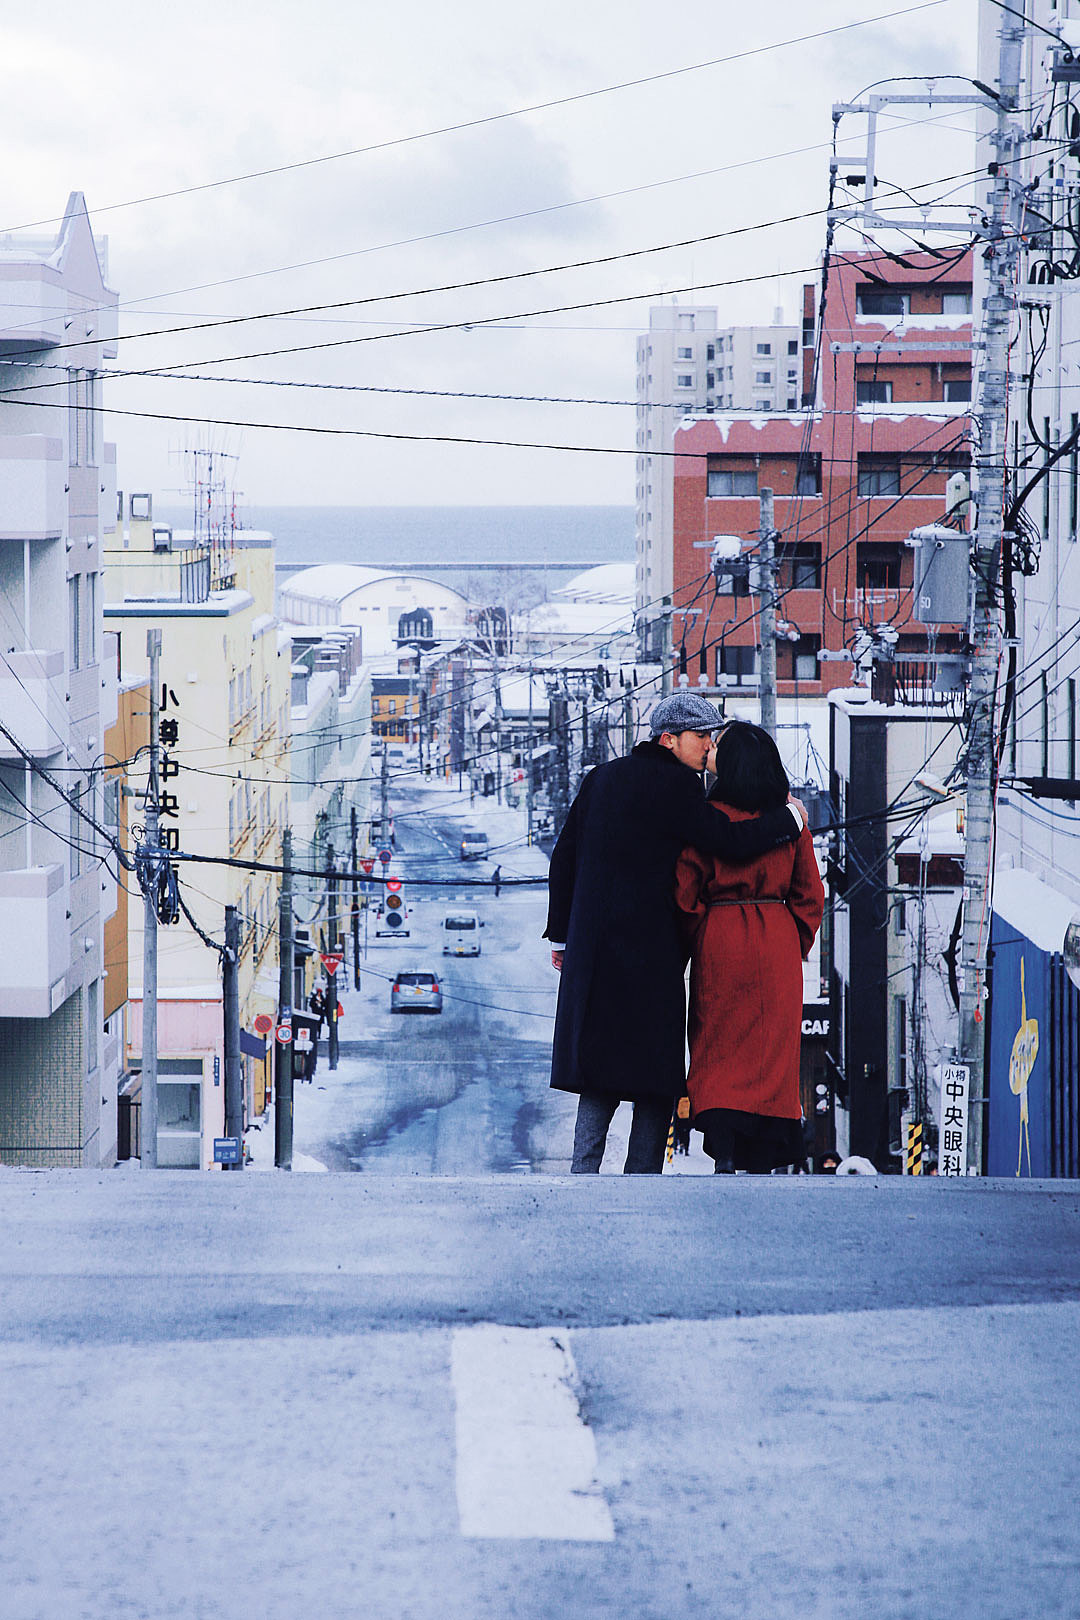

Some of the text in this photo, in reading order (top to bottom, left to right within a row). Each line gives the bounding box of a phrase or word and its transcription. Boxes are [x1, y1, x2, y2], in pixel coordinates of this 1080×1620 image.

[920, 596, 931, 608] 50
[279, 1029, 291, 1038] 30
[944, 1068, 966, 1082] 小樽
[943, 1081, 964, 1176] 中央眼科
